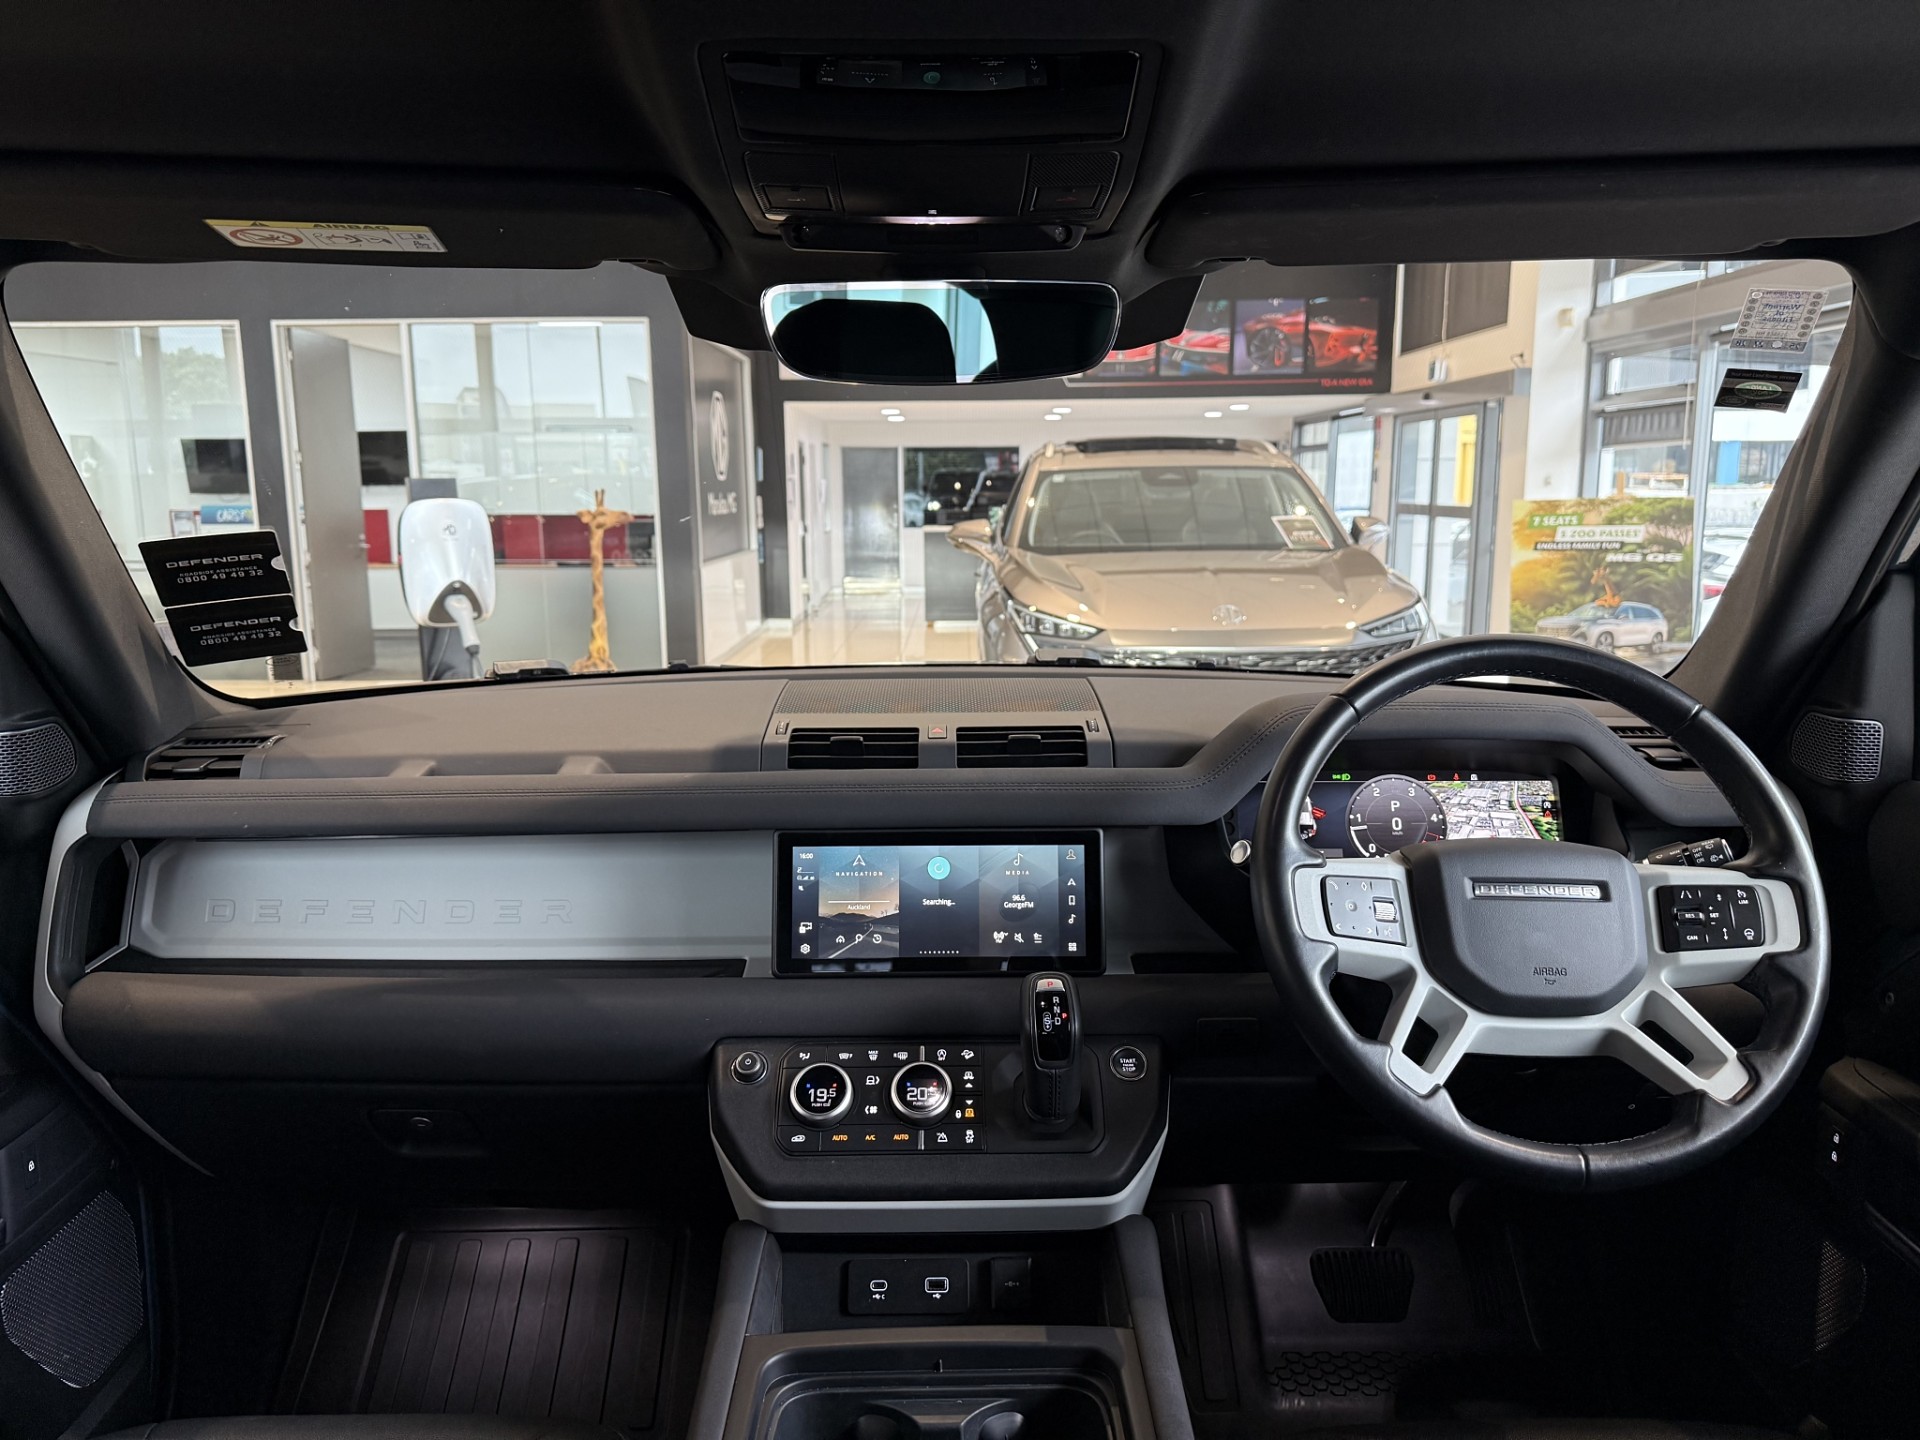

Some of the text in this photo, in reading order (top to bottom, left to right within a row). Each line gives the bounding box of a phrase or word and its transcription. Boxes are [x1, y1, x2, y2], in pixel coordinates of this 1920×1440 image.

[313, 223, 390, 231] AIRBAG
[1543, 515, 1579, 525] SEATS
[1570, 529, 1596, 539] ZOO
[165, 553, 264, 569] DEFENDER
[177, 574, 208, 584] 0800
[248, 569, 264, 577] 32
[179, 565, 258, 578] ROADSIDE ASSISTANCE
[189, 616, 282, 632] DEFENDER
[236, 627, 276, 636] ASSISTANCE
[200, 637, 229, 646] 0800
[268, 630, 282, 638] 32
[1373, 788, 1415, 796] 2 3
[1390, 800, 1400, 812] P
[1356, 814, 1361, 822] 1
[1431, 814, 1437, 822] 4
[1391, 817, 1402, 831] 0
[1369, 844, 1376, 852] 0
[1479, 884, 1600, 898] DEFENDER
[1003, 901, 1034, 910] GeorgeFM
[204, 899, 573, 924] DEFENDER
[1532, 966, 1568, 977] AIRBAG
[808, 1088, 837, 1102] 19.5
